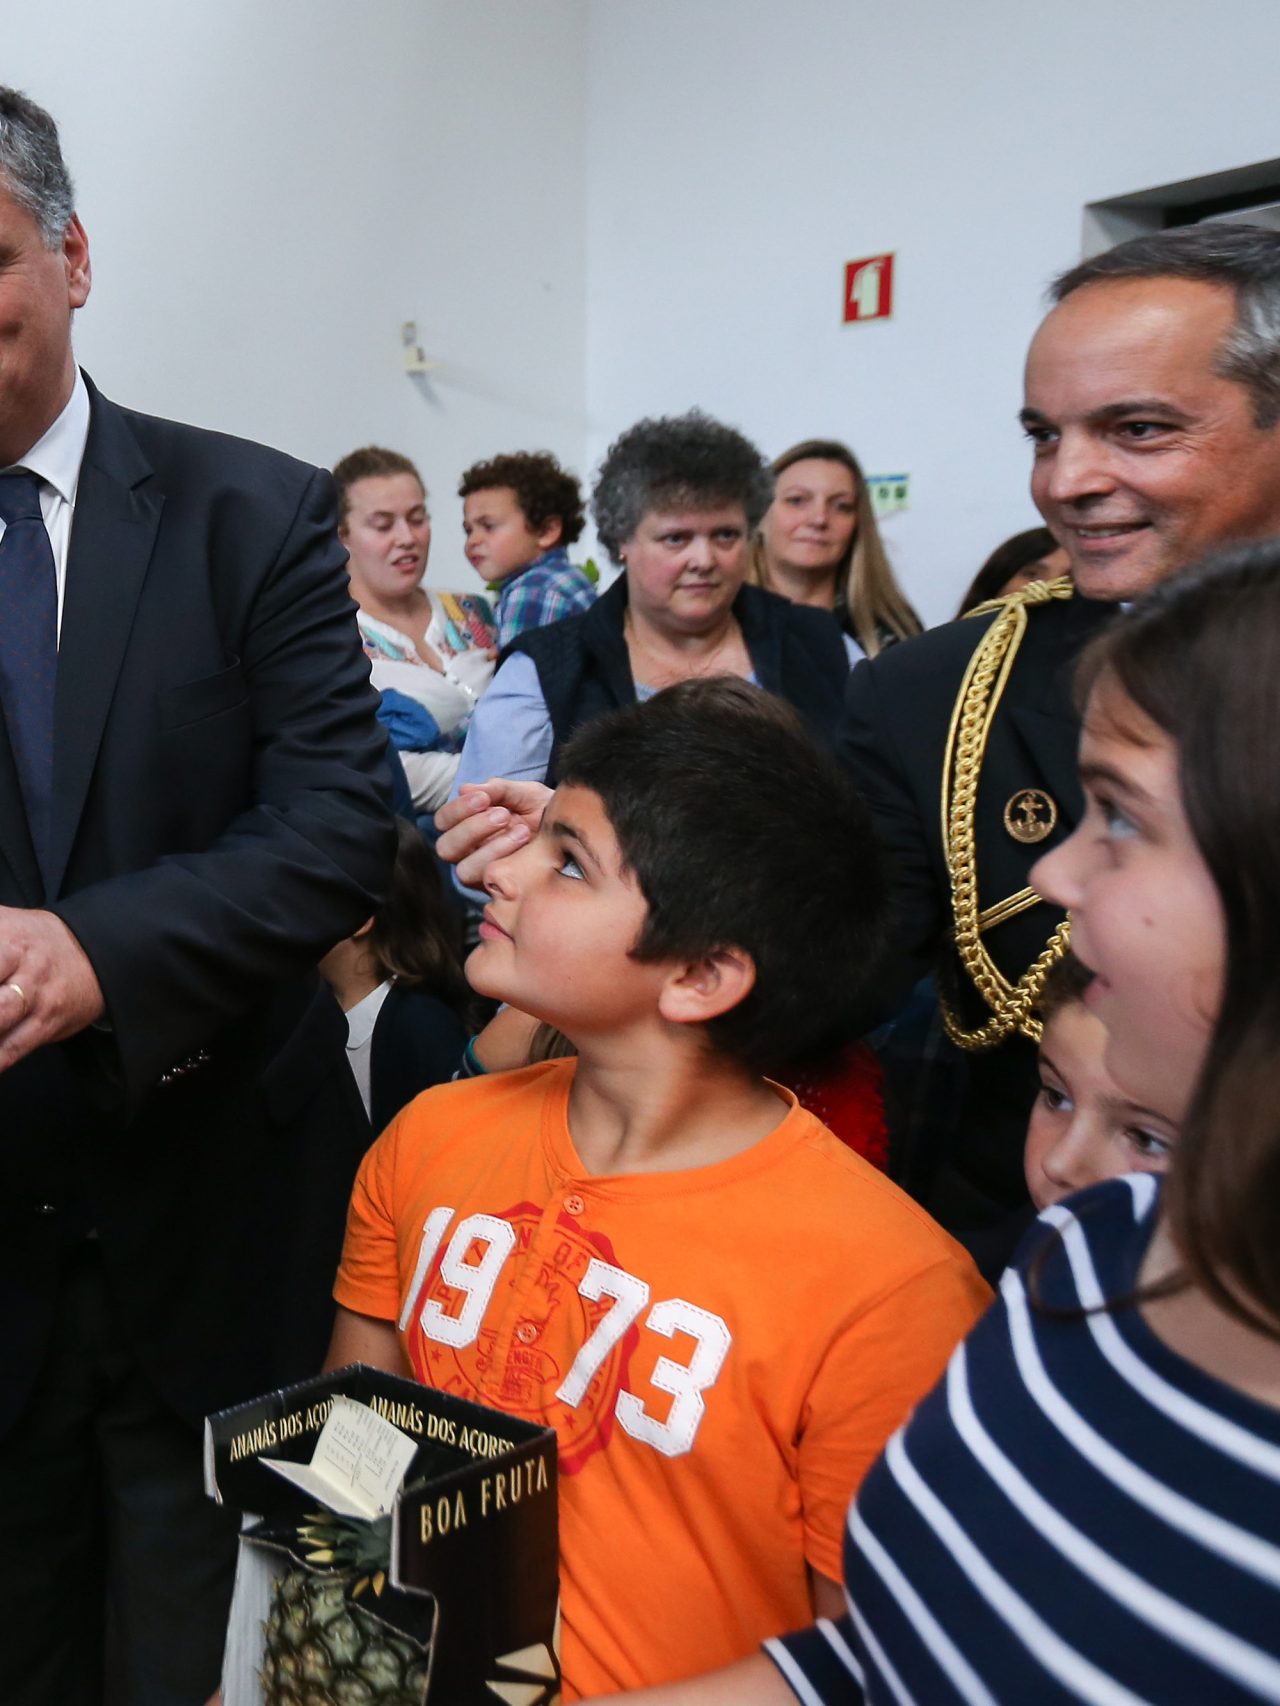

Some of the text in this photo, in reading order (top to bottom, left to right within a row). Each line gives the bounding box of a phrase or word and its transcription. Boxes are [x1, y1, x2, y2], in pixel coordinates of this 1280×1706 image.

[399, 1206, 732, 1458] 1973
[230, 1399, 335, 1462] ANANÁS DOS AÇO
[370, 1395, 423, 1434] ANANÁS
[427, 1413, 456, 1445] DOS
[421, 1455, 548, 1544] BOA FRUTA
